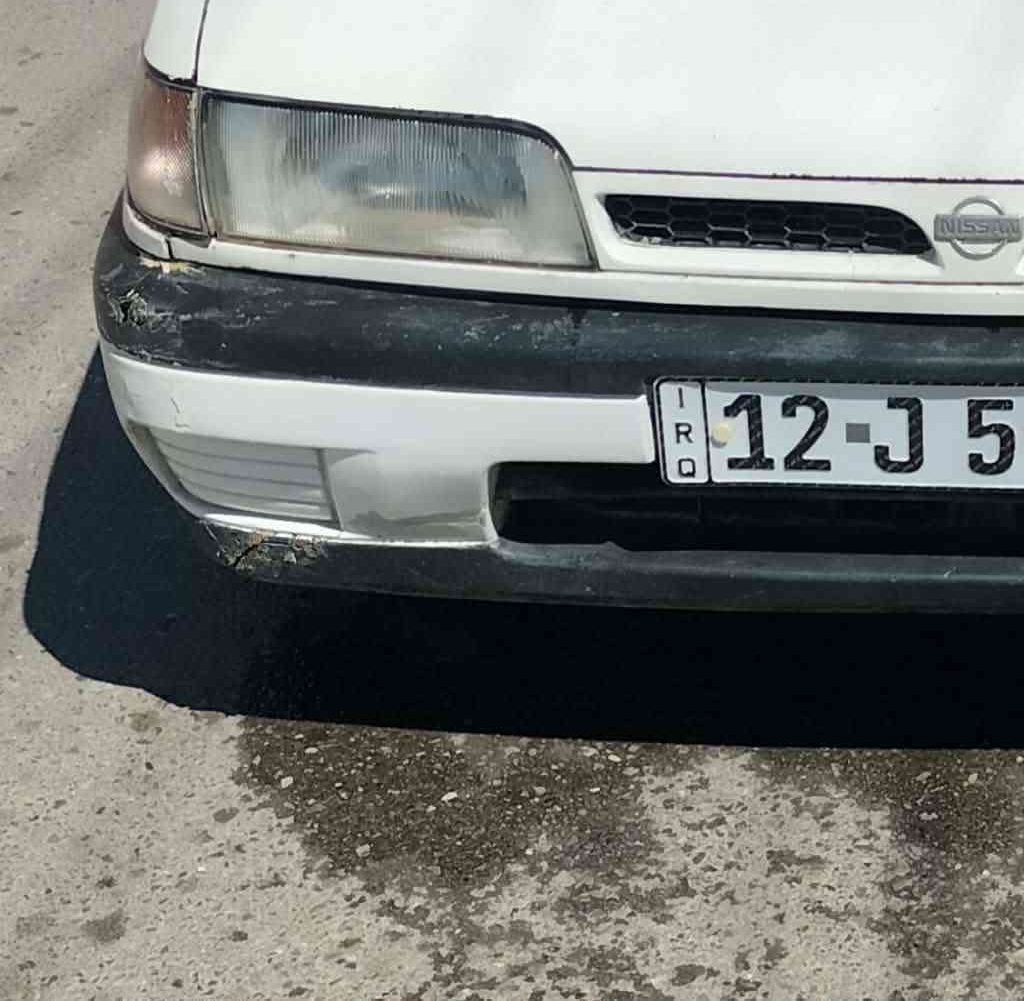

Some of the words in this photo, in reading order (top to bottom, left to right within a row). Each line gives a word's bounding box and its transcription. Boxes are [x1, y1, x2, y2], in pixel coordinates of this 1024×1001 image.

[942, 219, 1020, 237] NISSAN
[723, 394, 832, 471] 12
[874, 397, 924, 473] J
